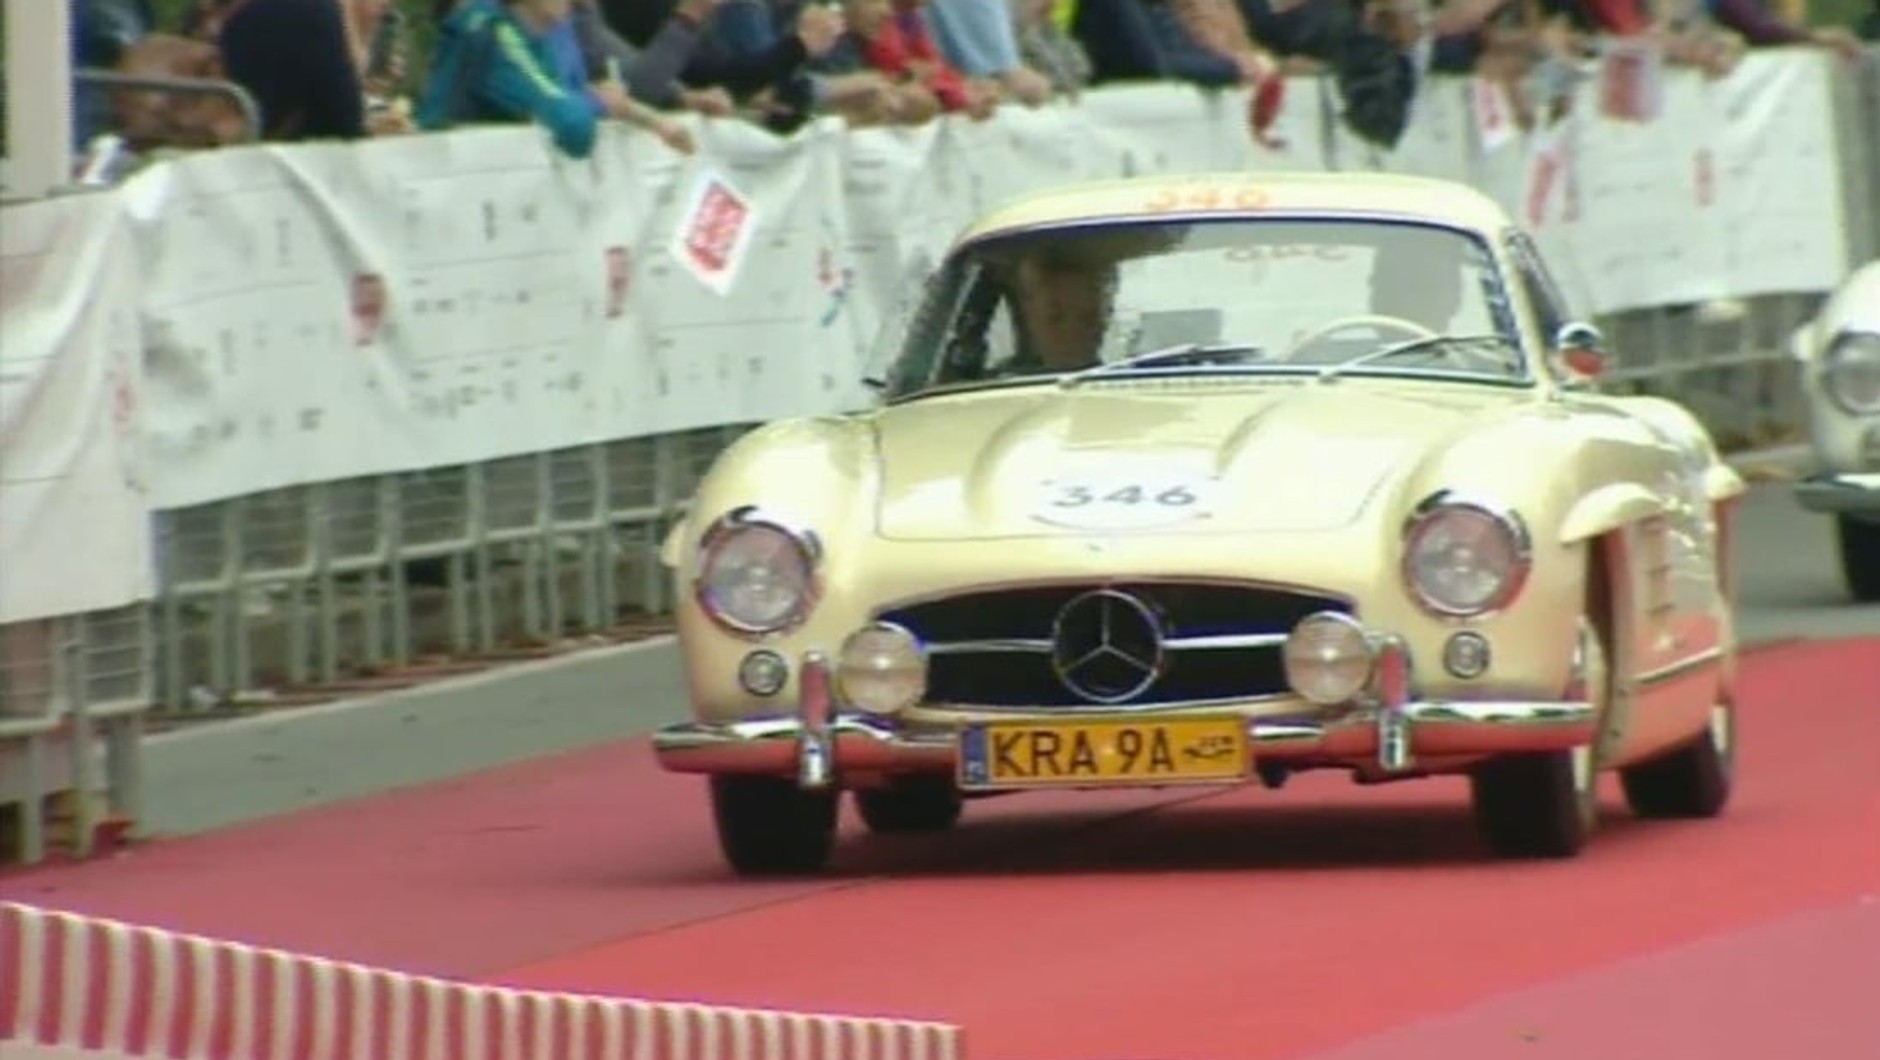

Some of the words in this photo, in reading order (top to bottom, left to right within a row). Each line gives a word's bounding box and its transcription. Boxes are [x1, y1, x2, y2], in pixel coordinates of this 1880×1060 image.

[1050, 484, 1197, 508] 346
[992, 729, 1098, 778] KRA
[1116, 726, 1175, 774] 9A
